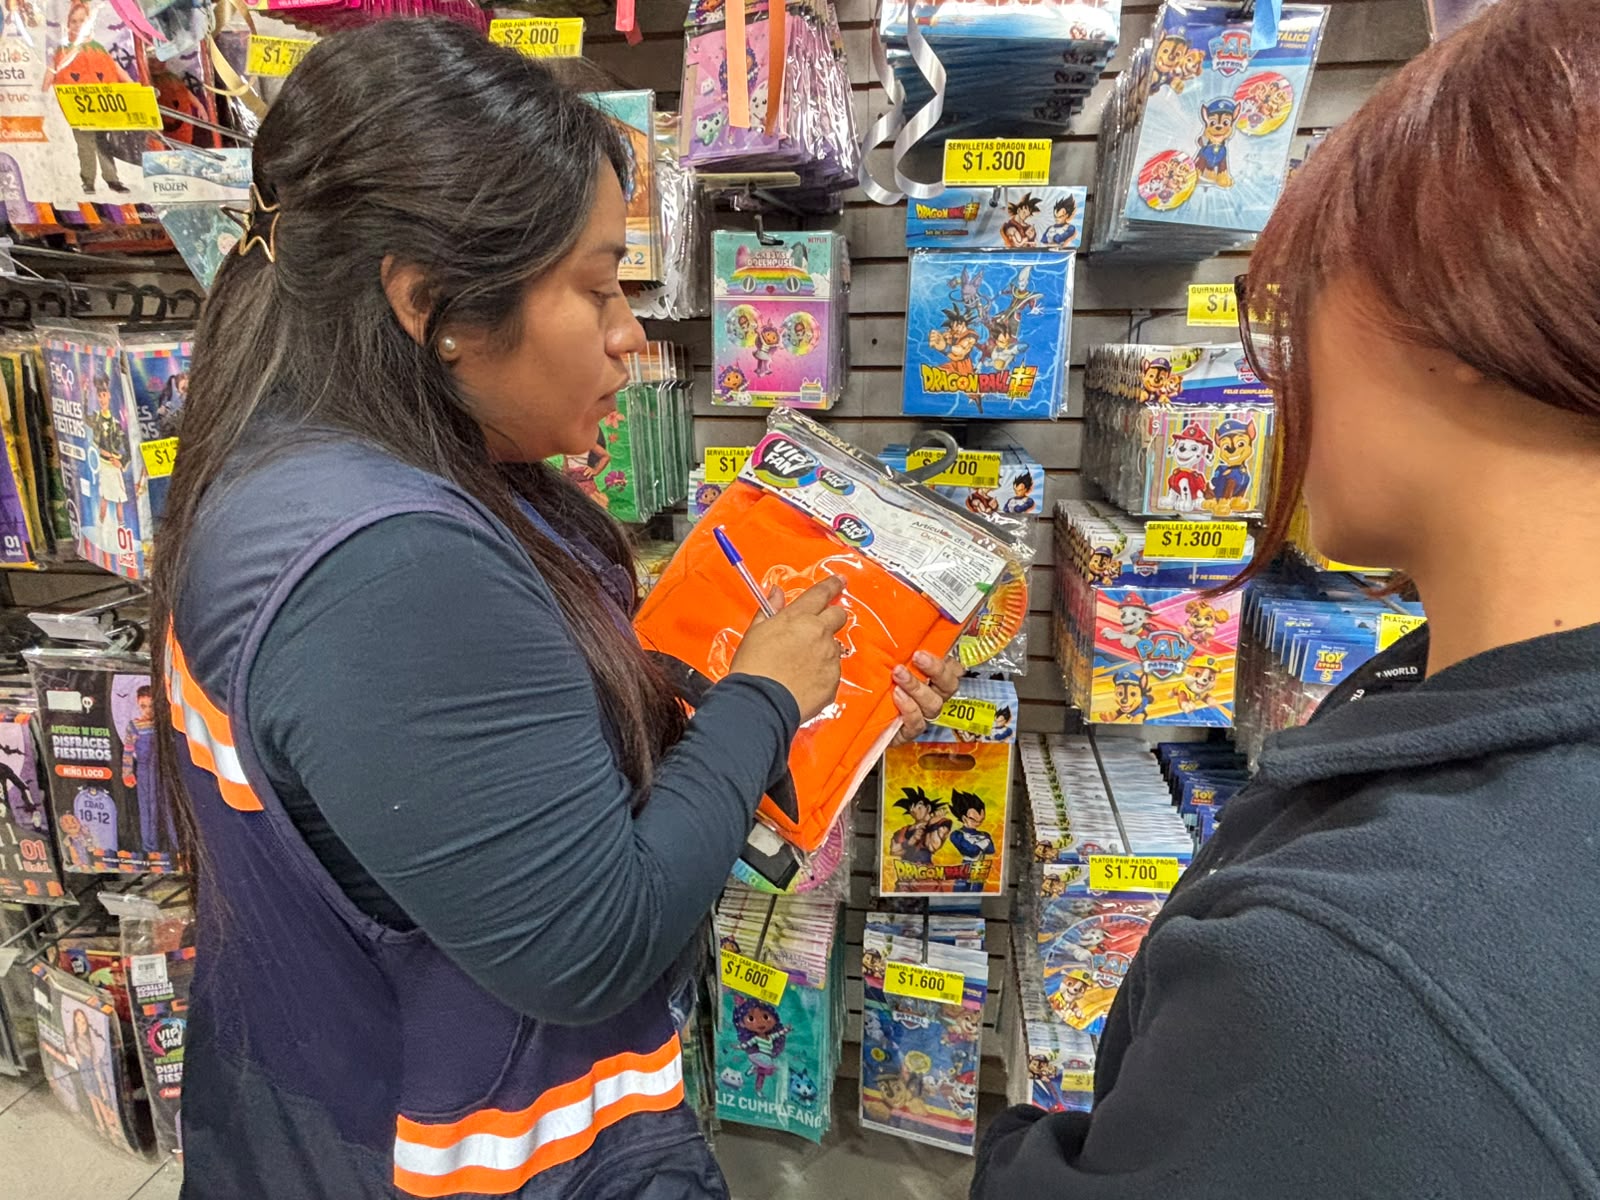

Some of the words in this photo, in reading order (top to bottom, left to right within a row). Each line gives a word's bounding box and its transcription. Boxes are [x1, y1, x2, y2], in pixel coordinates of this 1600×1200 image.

[504, 28, 559, 45] $2.000
[1216, 60, 1244, 69] PATROL
[75, 93, 127, 113] $2.000
[948, 142, 994, 150] SERVILLETAS
[996, 142, 1025, 150] DRAGON
[962, 151, 1026, 173] $1.300
[153, 181, 188, 192] FROZEN
[915, 203, 948, 219] DRAGON
[747, 258, 795, 267] DOLLHOUSE
[1191, 286, 1234, 294] GUIRNALDA
[921, 364, 979, 393] DRAGON
[979, 369, 1010, 393] BALL
[771, 441, 808, 465] VIP
[764, 451, 800, 475] FAN
[844, 518, 864, 534] VIP
[1211, 523, 1240, 531] PATROL
[4, 535, 21, 548] 01
[117, 527, 134, 552] 01
[1161, 531, 1223, 547] $1.300
[1136, 638, 1196, 661] PAW
[1317, 650, 1348, 663] TOY
[1147, 663, 1179, 671] PATROL
[52, 735, 110, 748] DISFRACES
[53, 747, 112, 761] FIESTEROS
[83, 767, 104, 777] LOCO
[1192, 789, 1217, 799] TOY
[84, 800, 104, 810] EDAD
[79, 809, 111, 824] 10-12
[20, 839, 47, 860] 01
[894, 859, 944, 880] DRAGON
[1104, 864, 1157, 880] $1.700
[725, 961, 769, 988] $1.600
[887, 963, 909, 973] MANTEL
[924, 969, 945, 978] PATROL
[898, 971, 945, 991] $1.600
[156, 1027, 181, 1041] VIP
[162, 1038, 182, 1049] FAN
